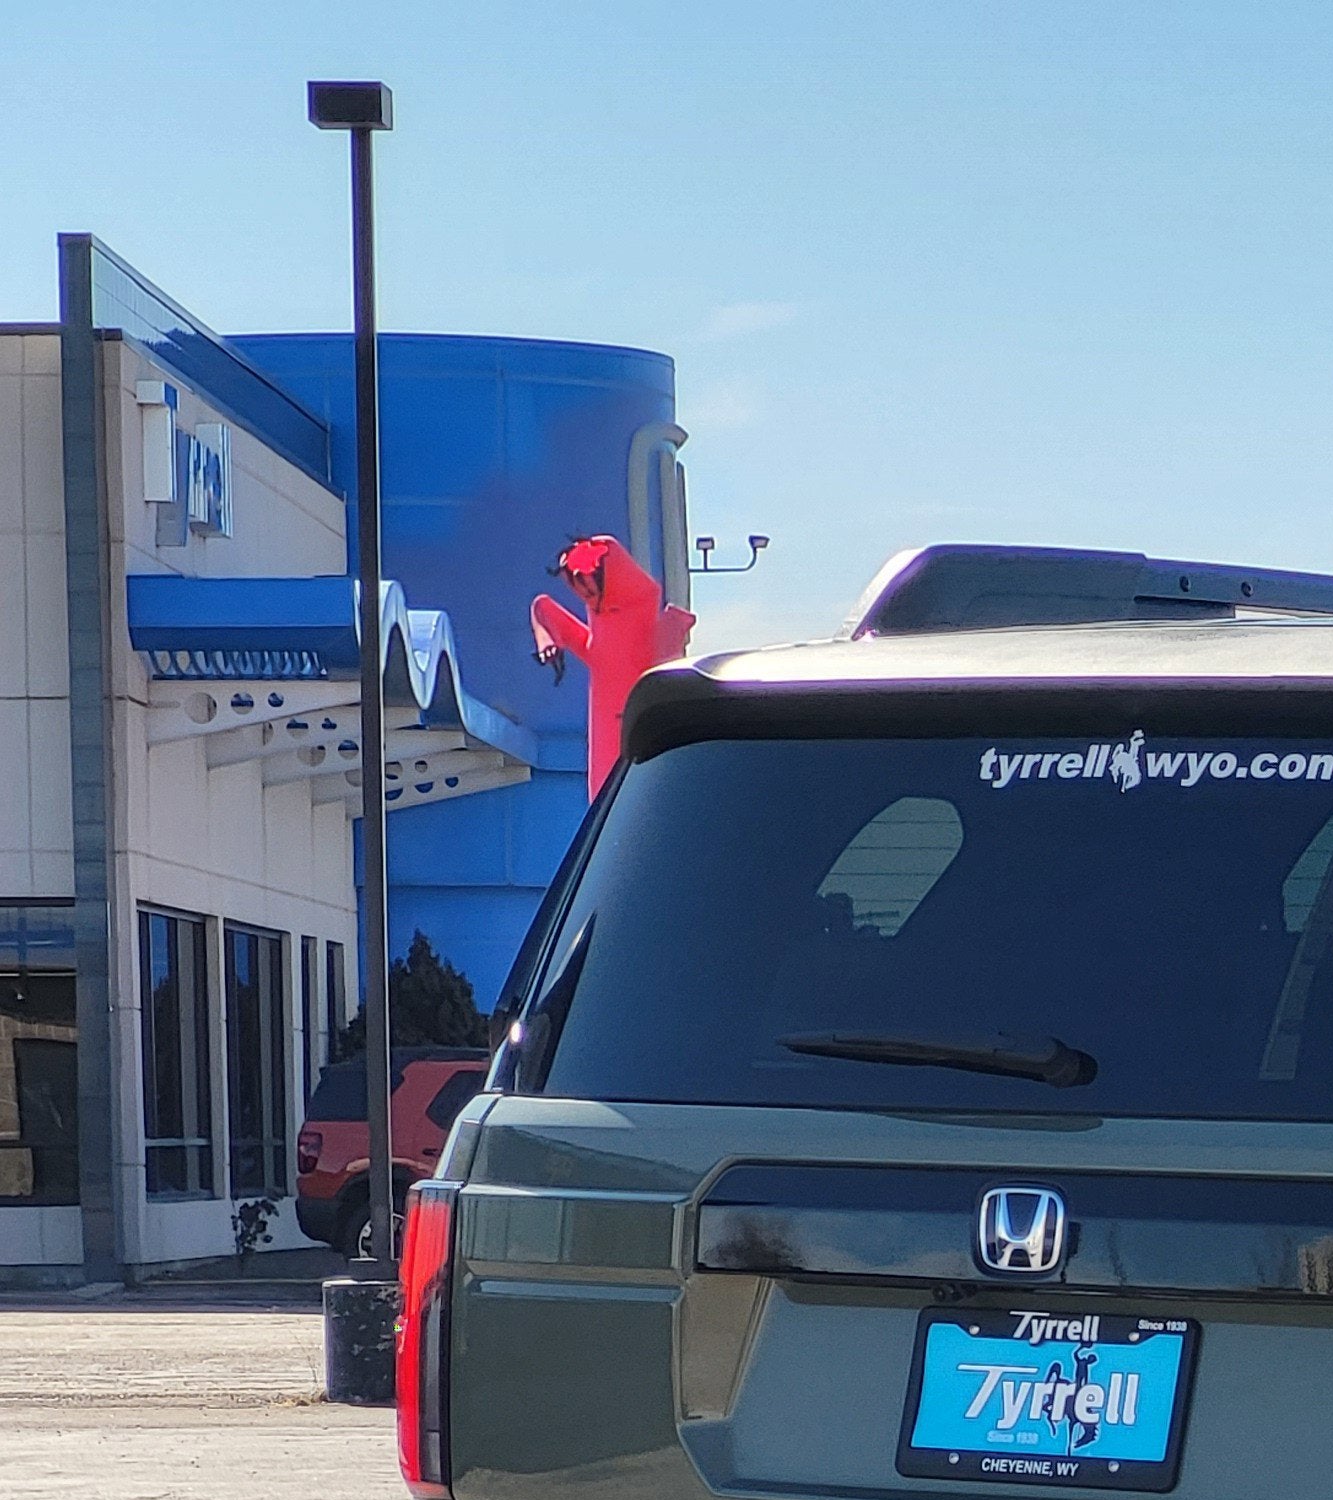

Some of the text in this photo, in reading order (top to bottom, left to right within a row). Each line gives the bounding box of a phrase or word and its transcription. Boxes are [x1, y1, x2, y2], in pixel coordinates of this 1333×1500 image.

[1009, 1310, 1100, 1345] Tyrrell
[1138, 1318, 1165, 1331] Since
[957, 1363, 1141, 1431] Tyrrell
[981, 1457, 1080, 1478] CHEYENNE, WY
